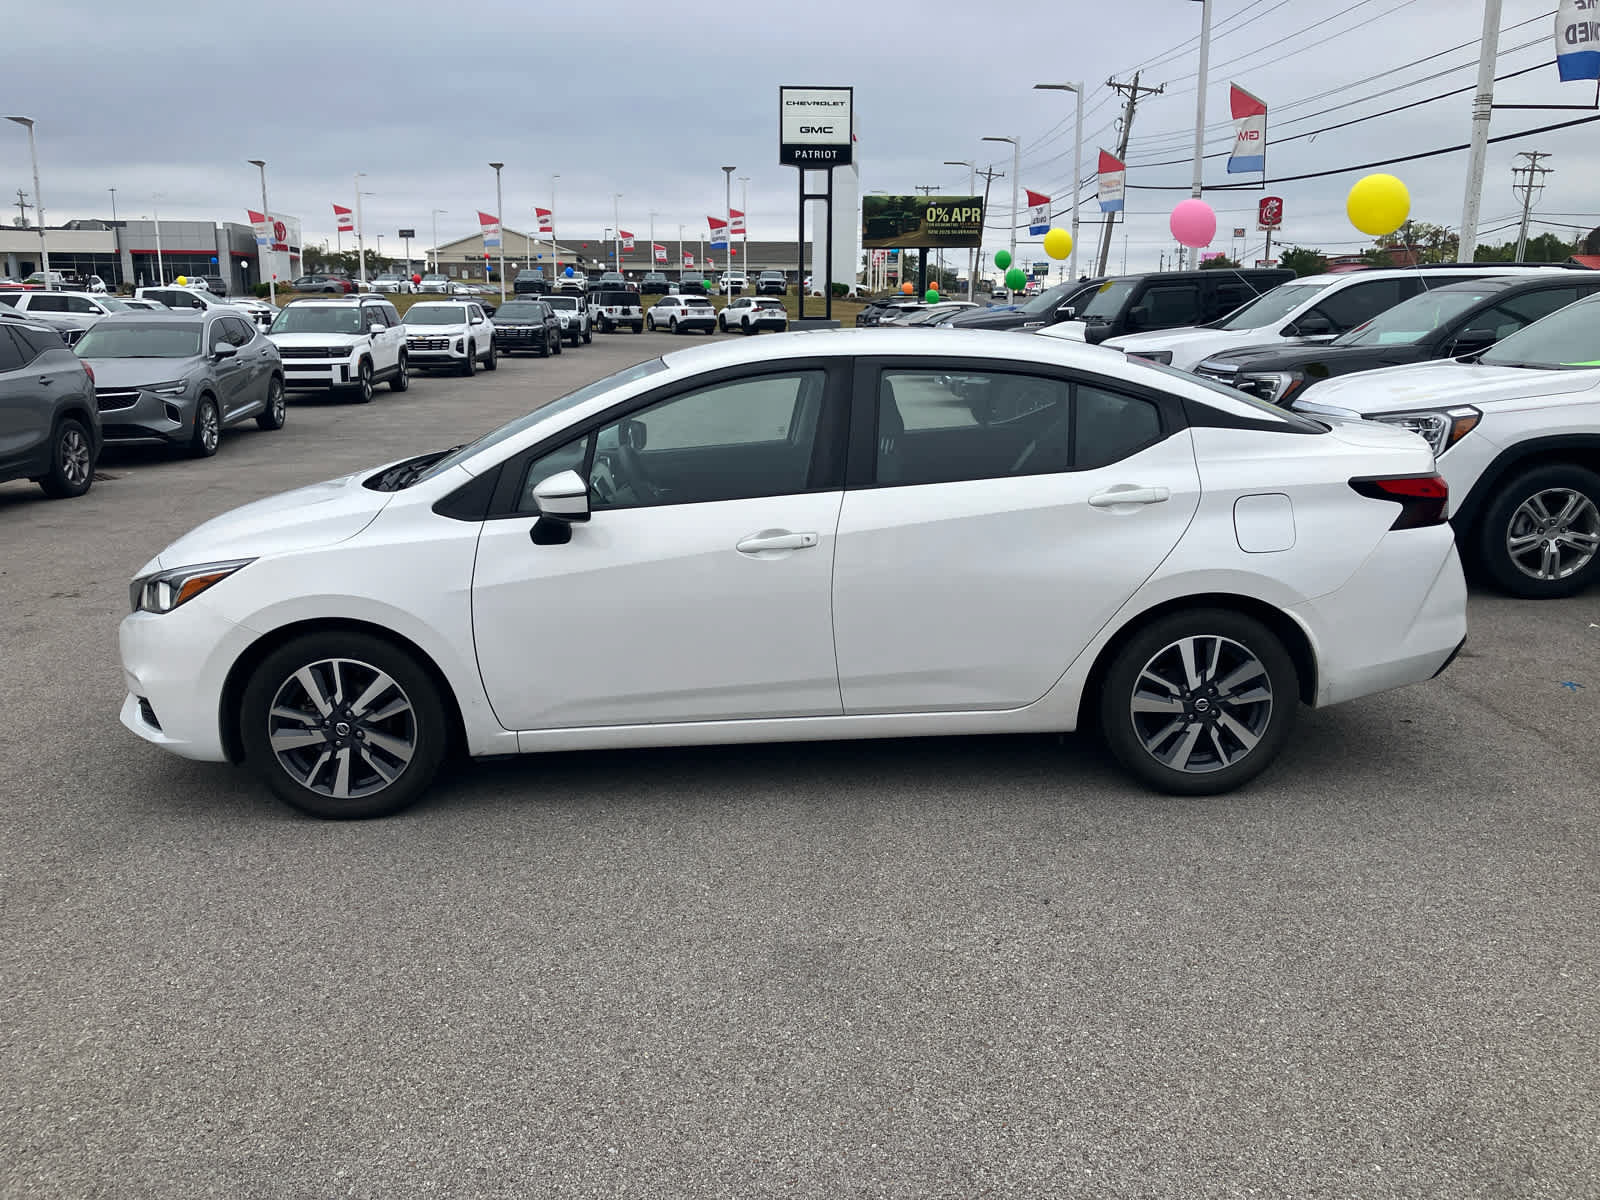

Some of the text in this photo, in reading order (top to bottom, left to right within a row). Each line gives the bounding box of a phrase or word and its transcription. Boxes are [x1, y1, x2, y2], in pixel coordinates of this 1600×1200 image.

[799, 126, 833, 134] GMC
[794, 150, 837, 159] PATRIOT
[926, 207, 981, 222] 0% APR
